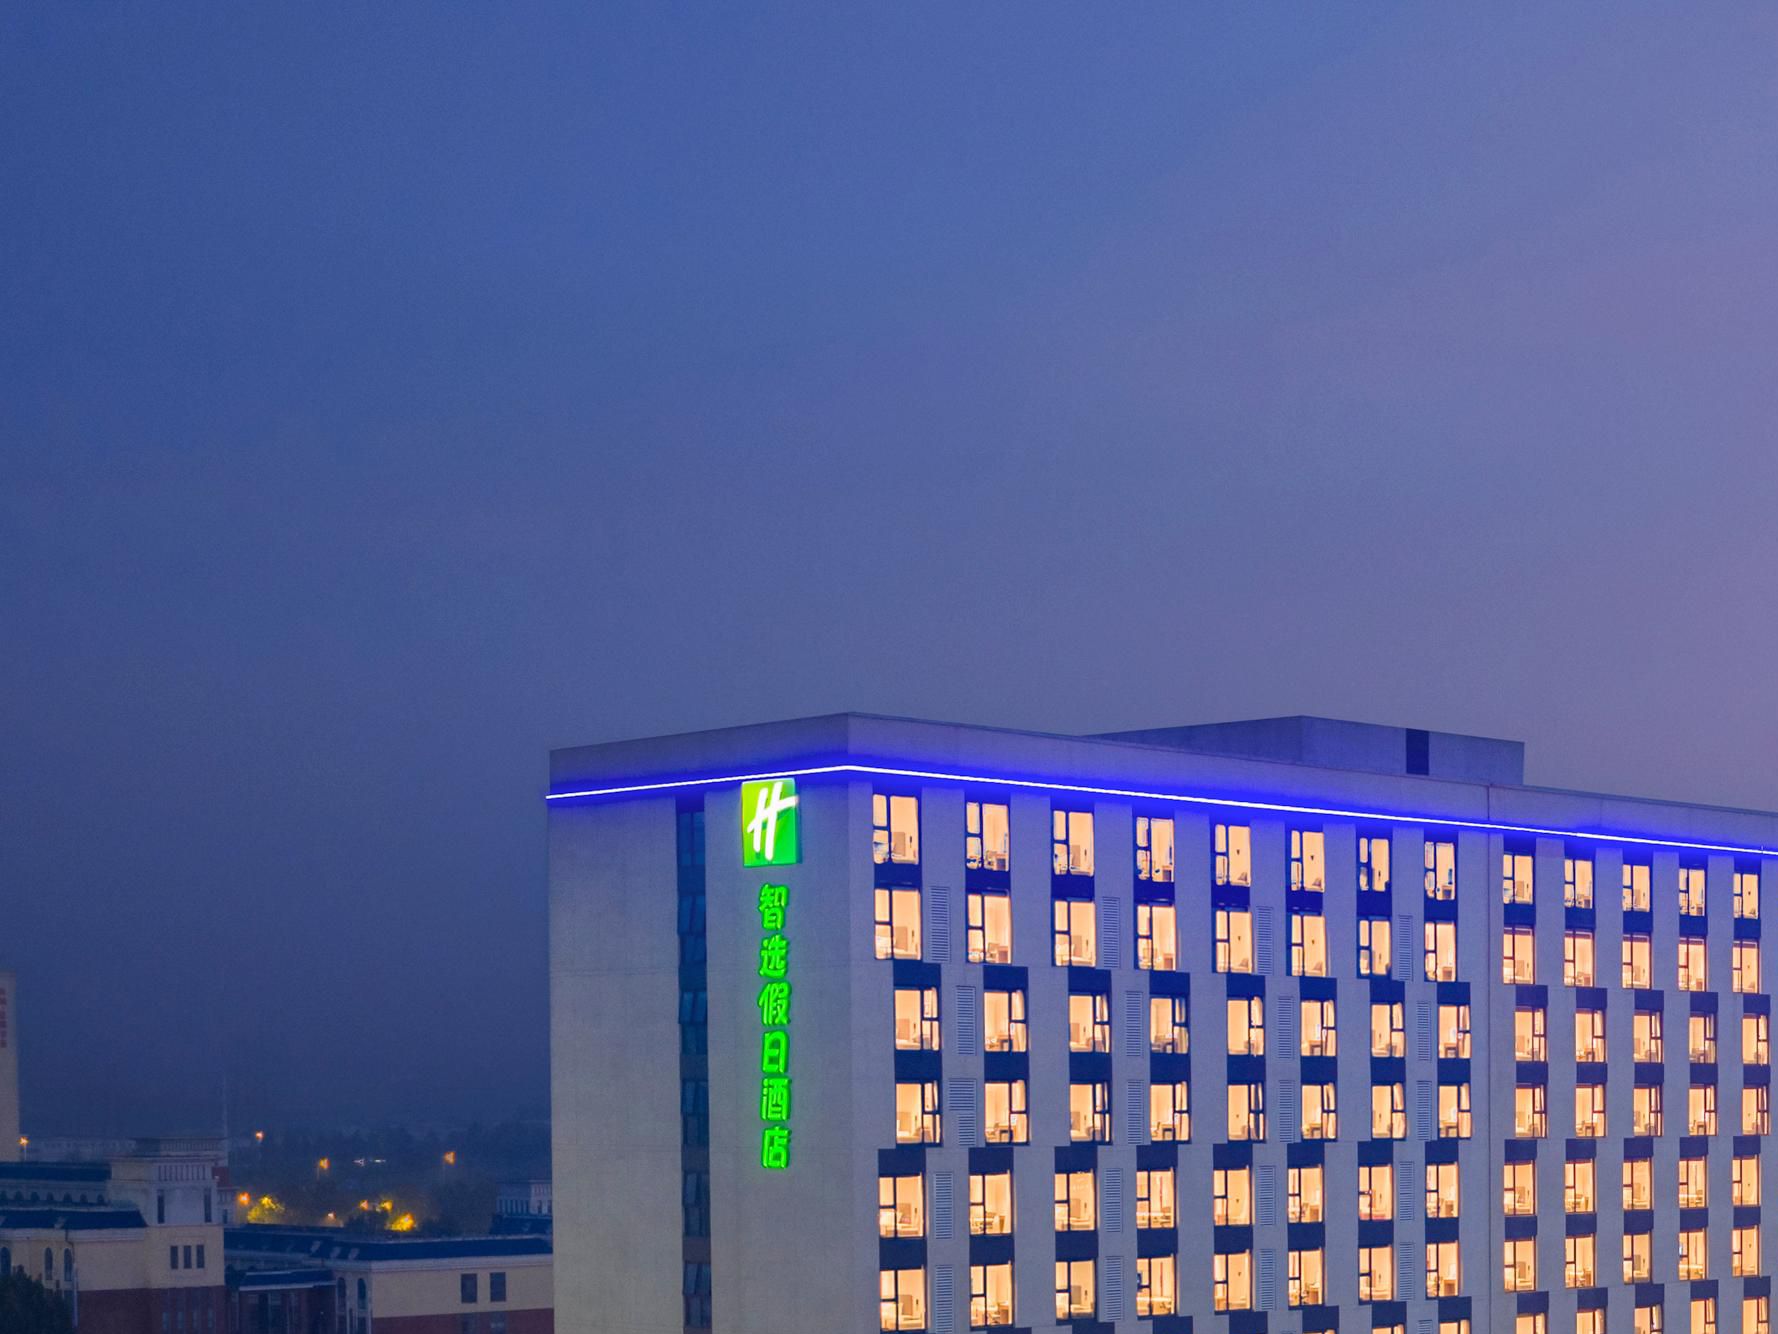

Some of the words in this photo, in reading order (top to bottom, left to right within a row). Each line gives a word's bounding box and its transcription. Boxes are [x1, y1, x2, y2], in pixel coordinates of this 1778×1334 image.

[757, 883, 792, 1170] 智选假日酒店
